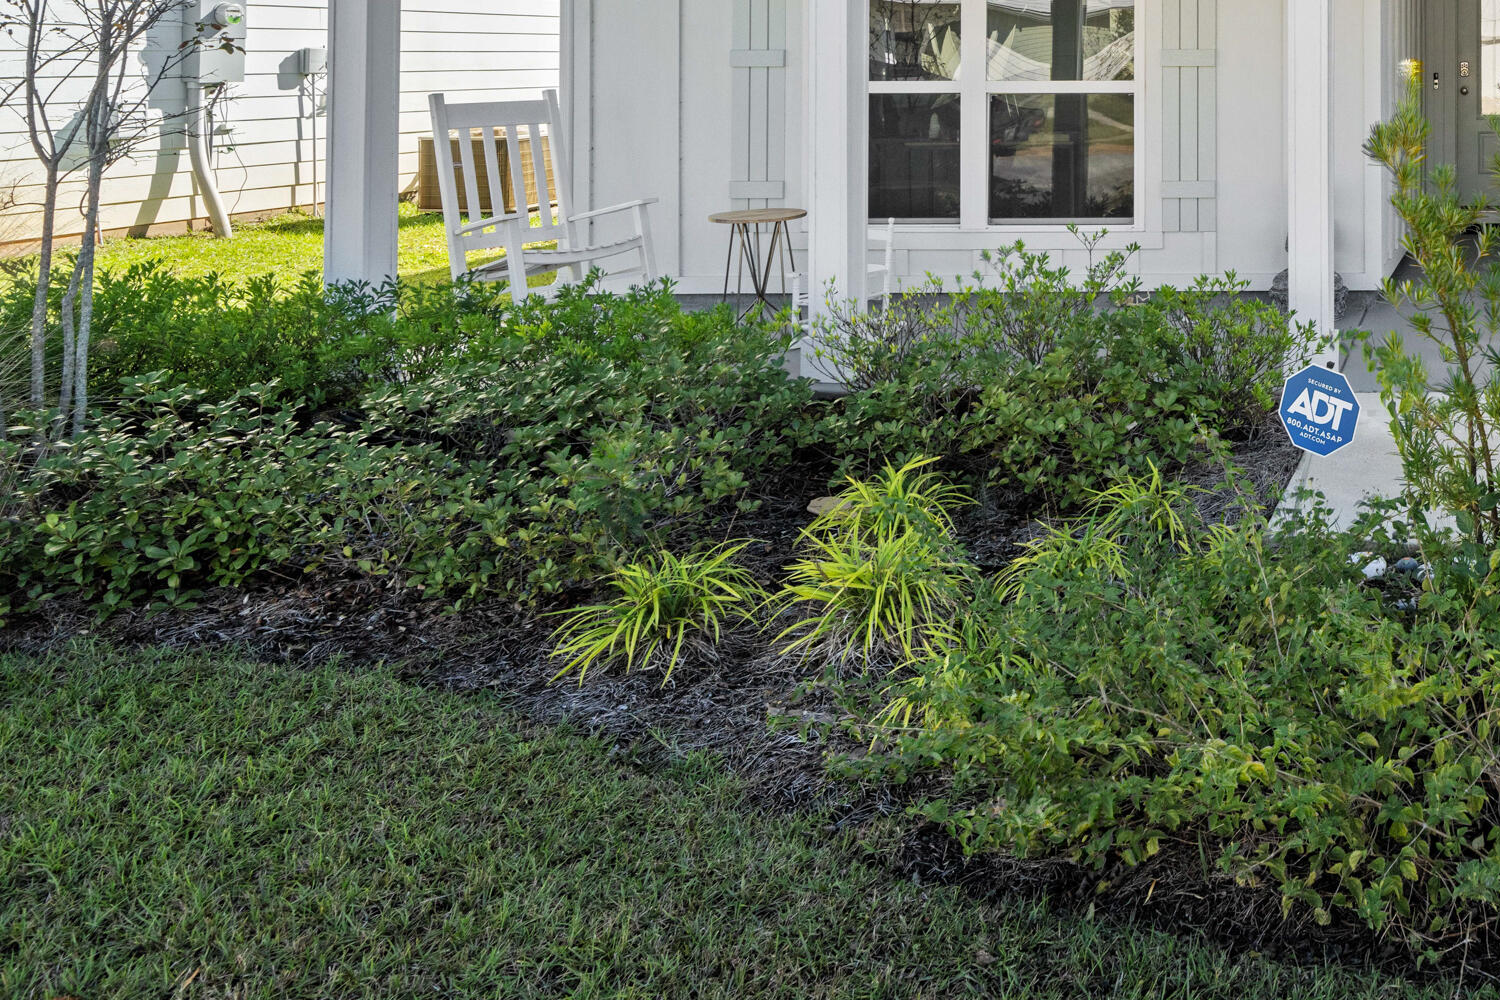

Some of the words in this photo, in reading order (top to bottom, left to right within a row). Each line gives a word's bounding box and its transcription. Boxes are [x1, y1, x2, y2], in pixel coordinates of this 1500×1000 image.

[1308, 378, 1333, 392] SECURED
[1333, 387, 1342, 395] BY
[1287, 387, 1354, 431] ADT
[1287, 417, 1343, 443] 800.ADT.ASAP
[1299, 431, 1326, 445] ADT.COM
